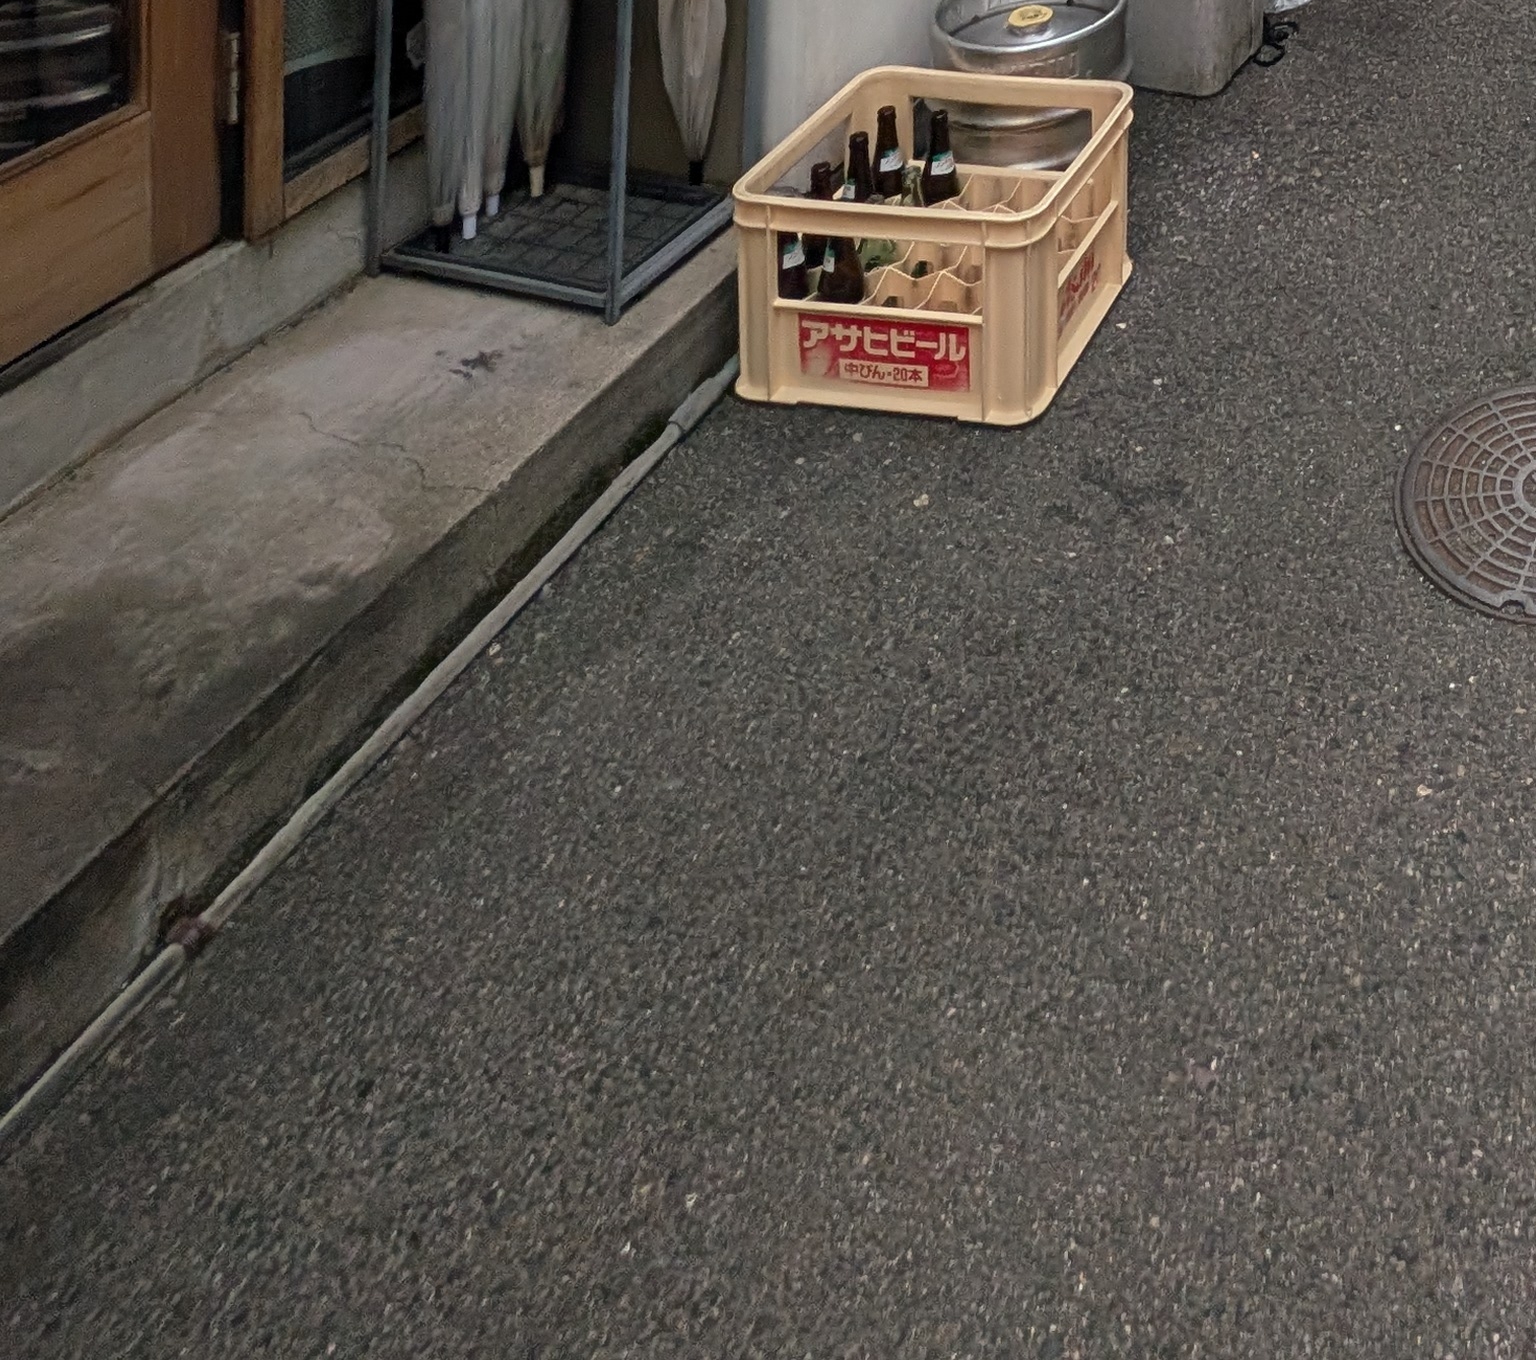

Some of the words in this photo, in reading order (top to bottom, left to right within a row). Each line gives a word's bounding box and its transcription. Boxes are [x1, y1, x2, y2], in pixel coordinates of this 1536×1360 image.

[801, 320, 967, 362] アサヒビール
